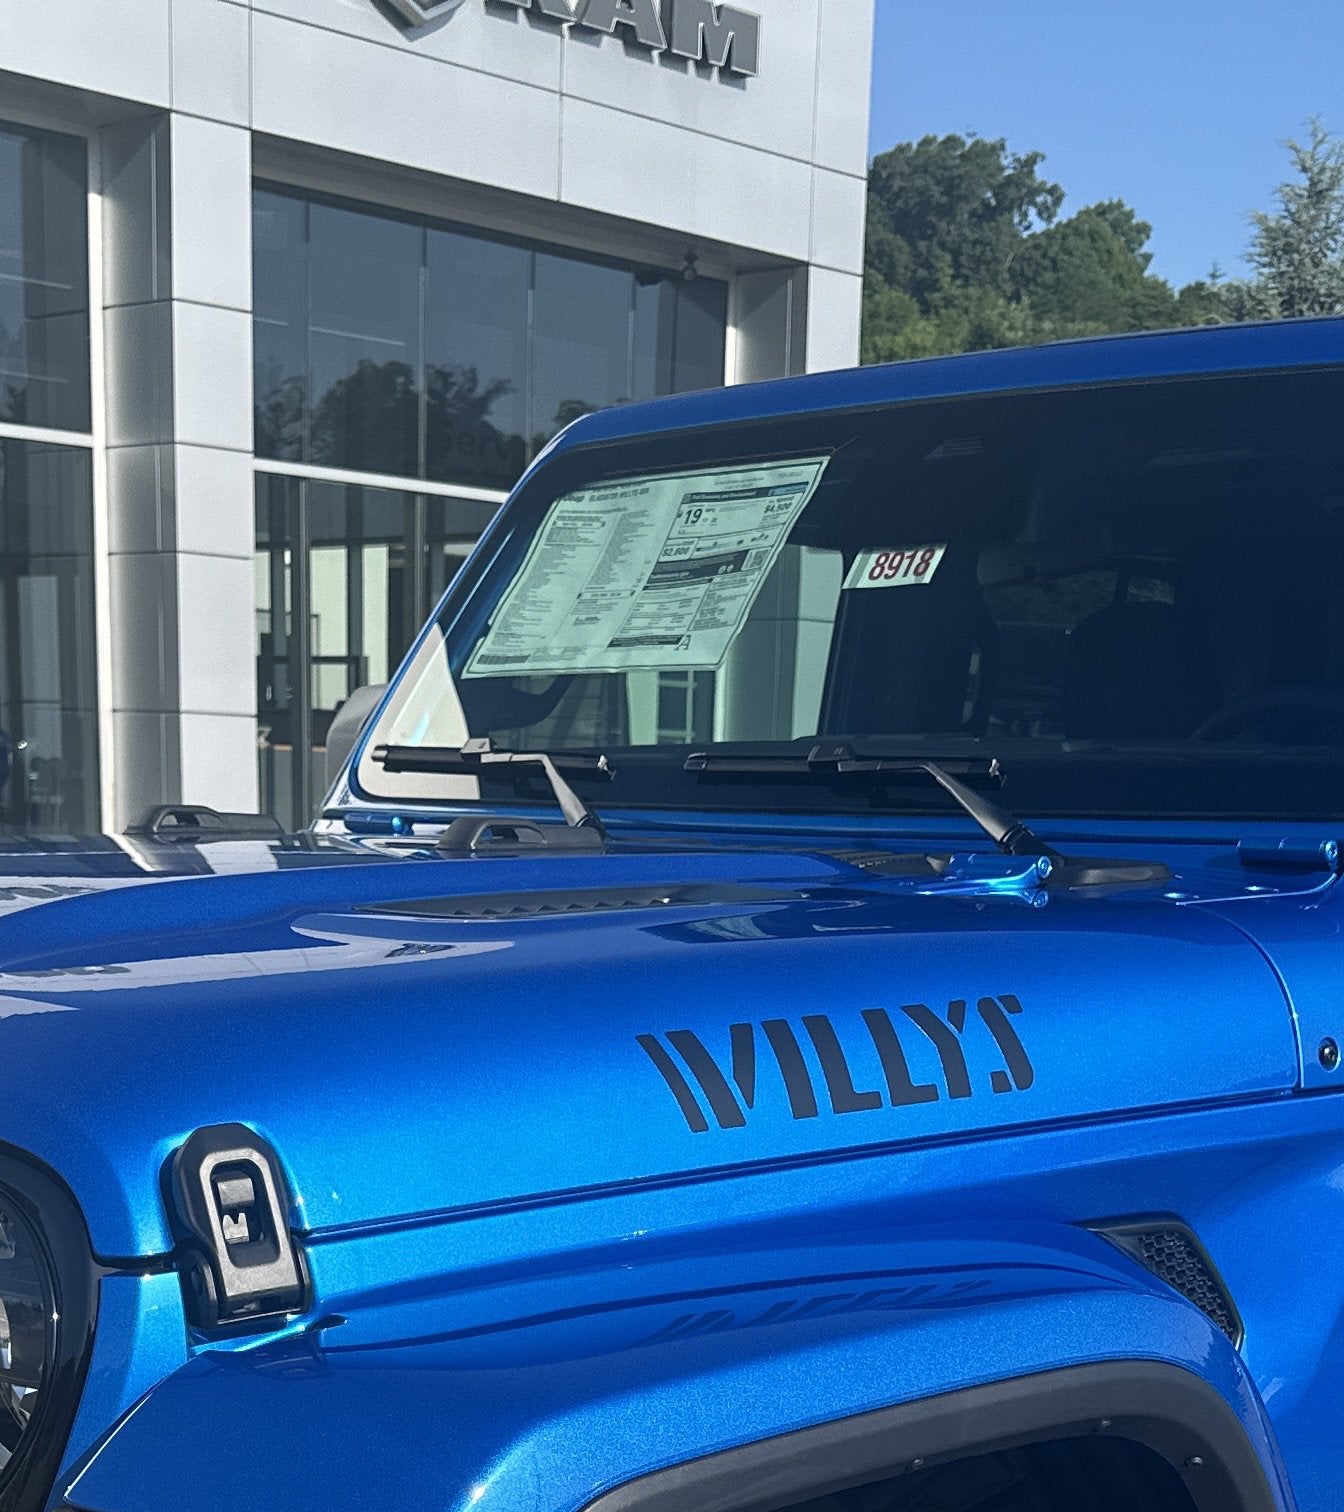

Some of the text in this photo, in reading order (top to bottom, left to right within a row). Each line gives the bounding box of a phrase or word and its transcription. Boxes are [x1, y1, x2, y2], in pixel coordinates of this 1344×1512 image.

[684, 508, 703, 525] 19
[868, 548, 936, 581] 8918
[634, 994, 1034, 1134] WILLYS
